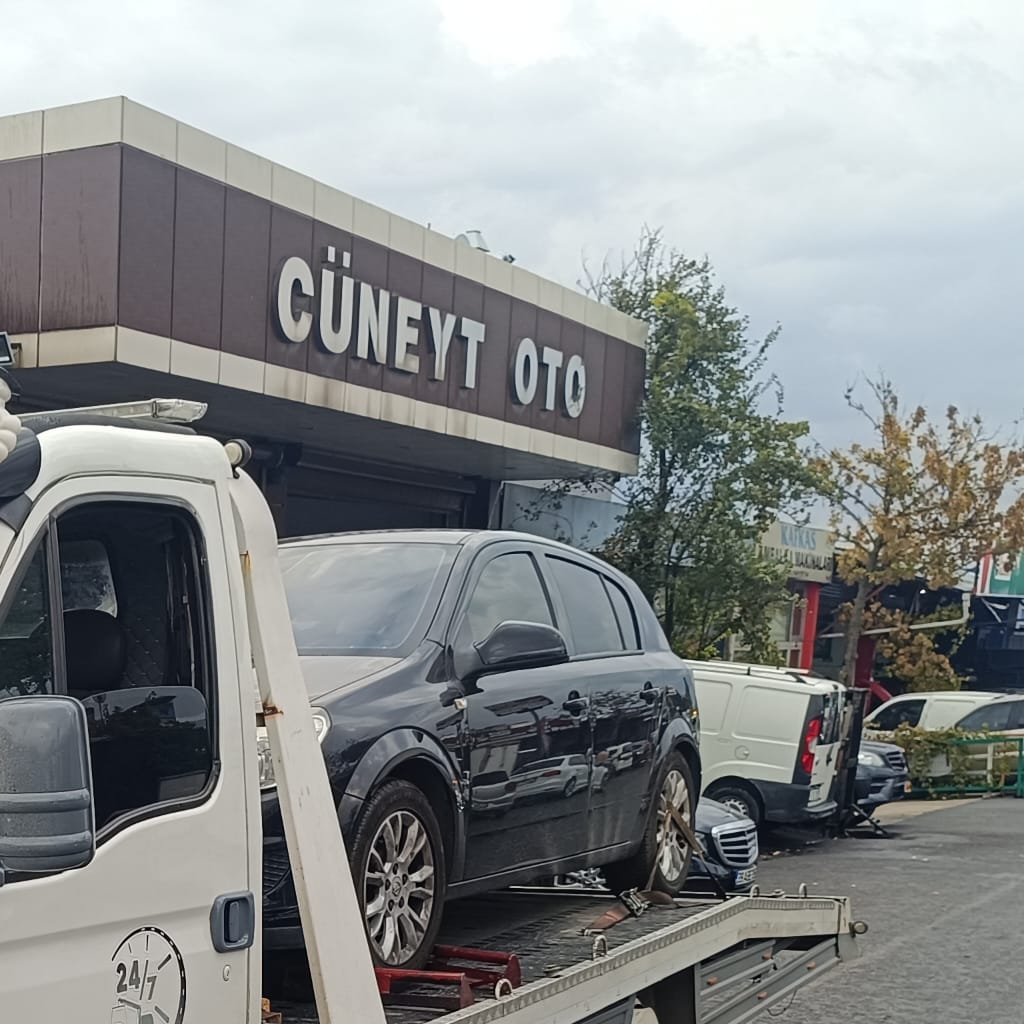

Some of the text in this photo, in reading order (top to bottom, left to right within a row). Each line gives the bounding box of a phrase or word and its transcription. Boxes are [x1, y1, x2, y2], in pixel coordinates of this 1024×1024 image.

[278, 245, 586, 418] CÜNEYT OTO
[116, 960, 157, 1000] 24/7
